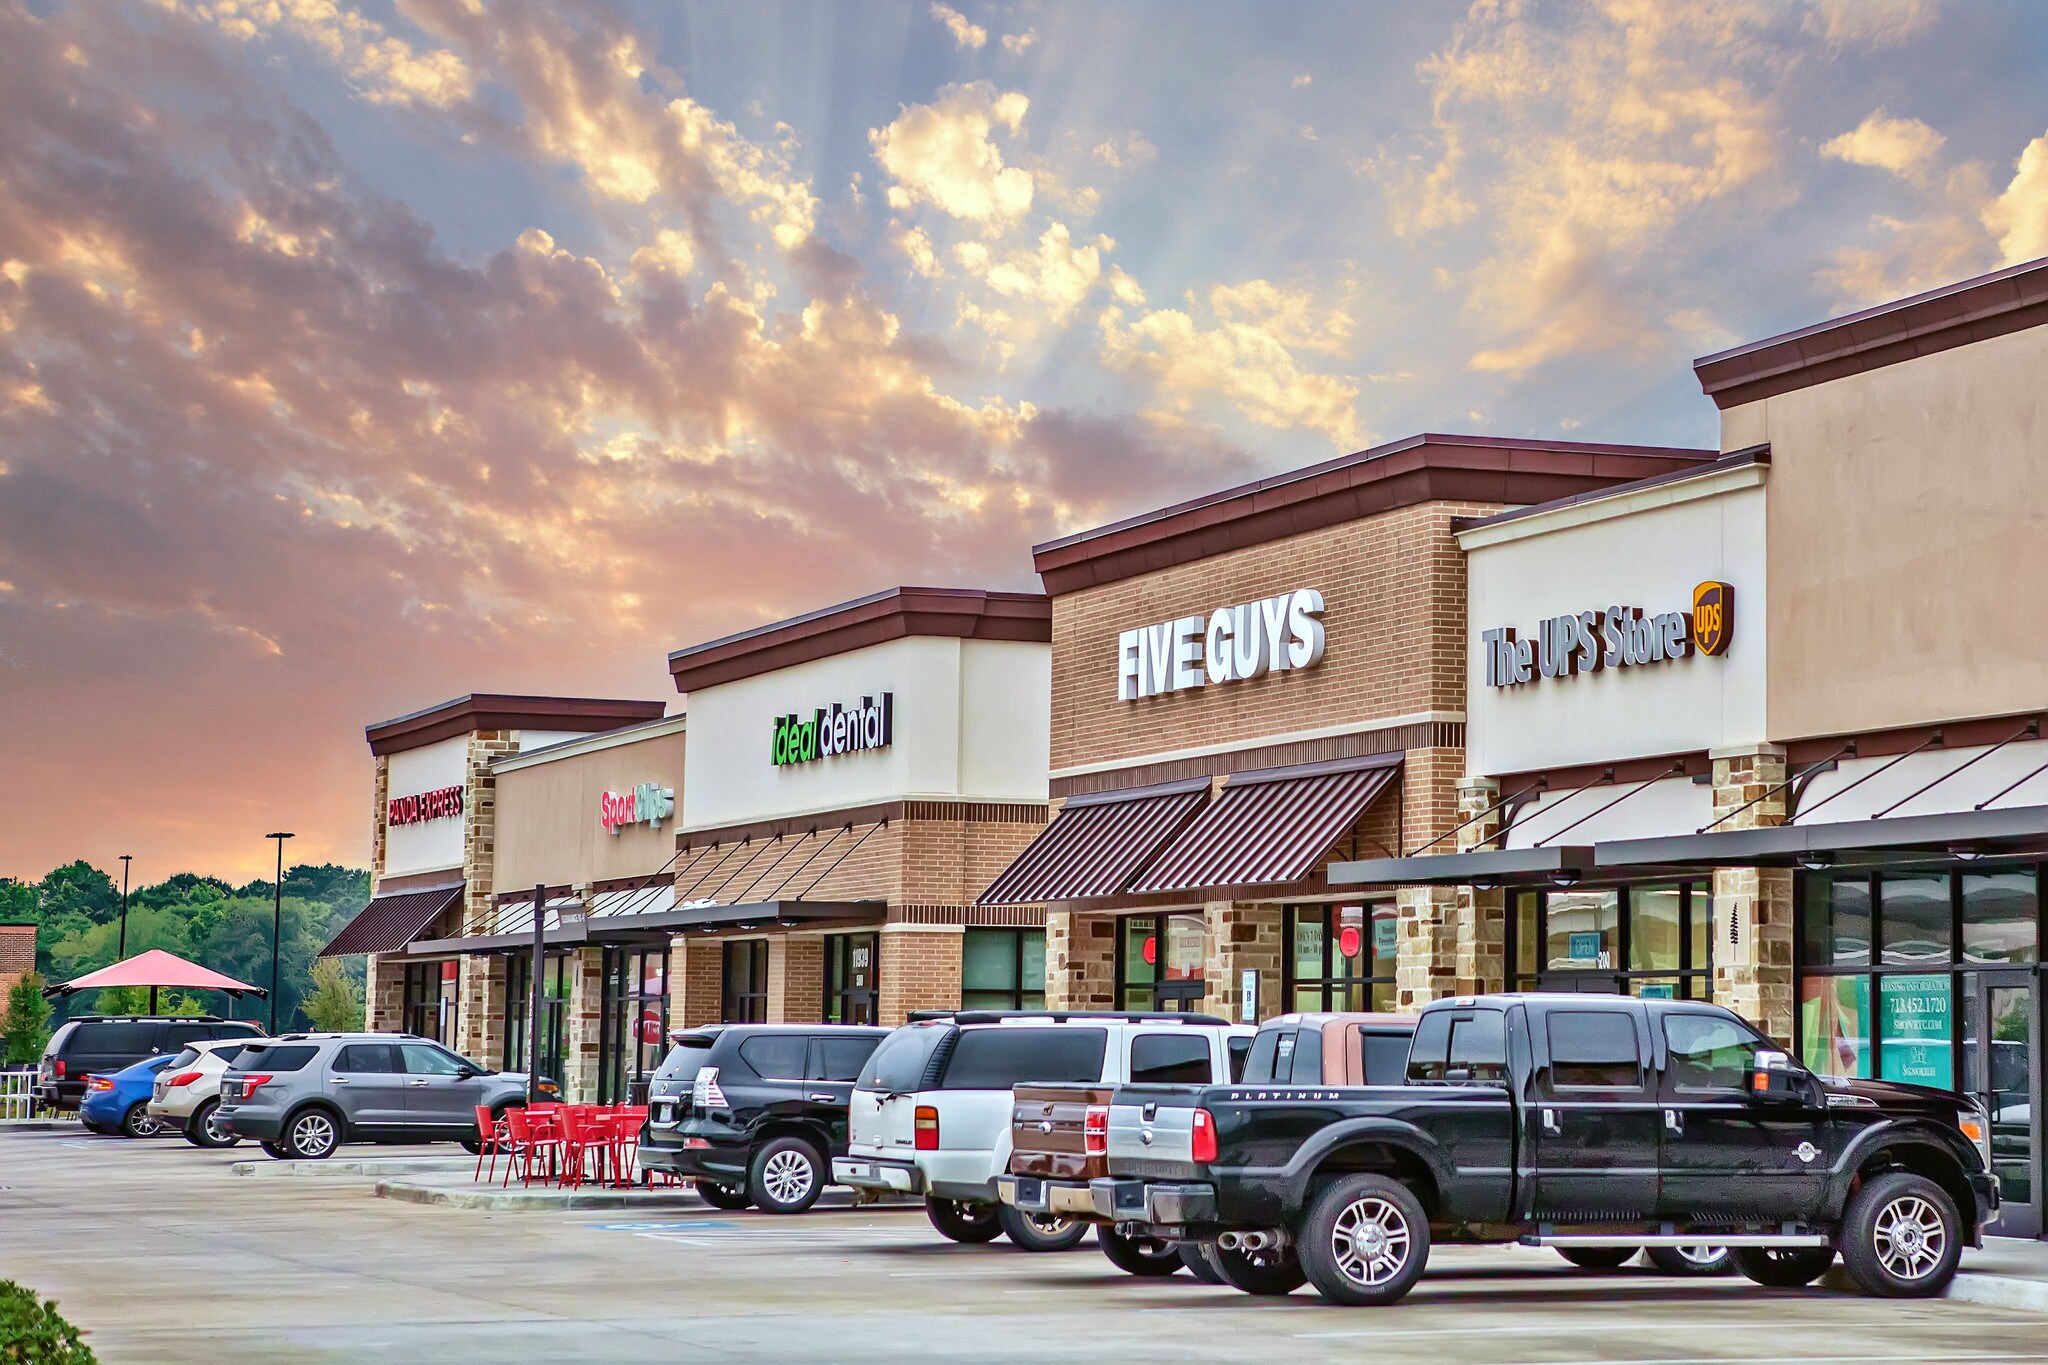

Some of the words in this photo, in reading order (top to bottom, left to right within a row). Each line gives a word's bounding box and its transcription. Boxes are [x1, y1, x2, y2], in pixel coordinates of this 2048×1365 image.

[1696, 603, 1720, 644] ups
[1118, 616, 1204, 702] FIVE
[1206, 588, 1325, 685] GUYS
[1482, 627, 1537, 688] The
[1539, 610, 1602, 679] UPS
[1603, 605, 1692, 669] Store
[771, 708, 823, 767] ideal
[821, 691, 893, 757] dental
[389, 795, 420, 827] PANDA
[420, 785, 463, 822] EXPRESS
[1890, 997, 1947, 1014] 713.452.1720
[1231, 1092, 1339, 1101] PLATINUM
